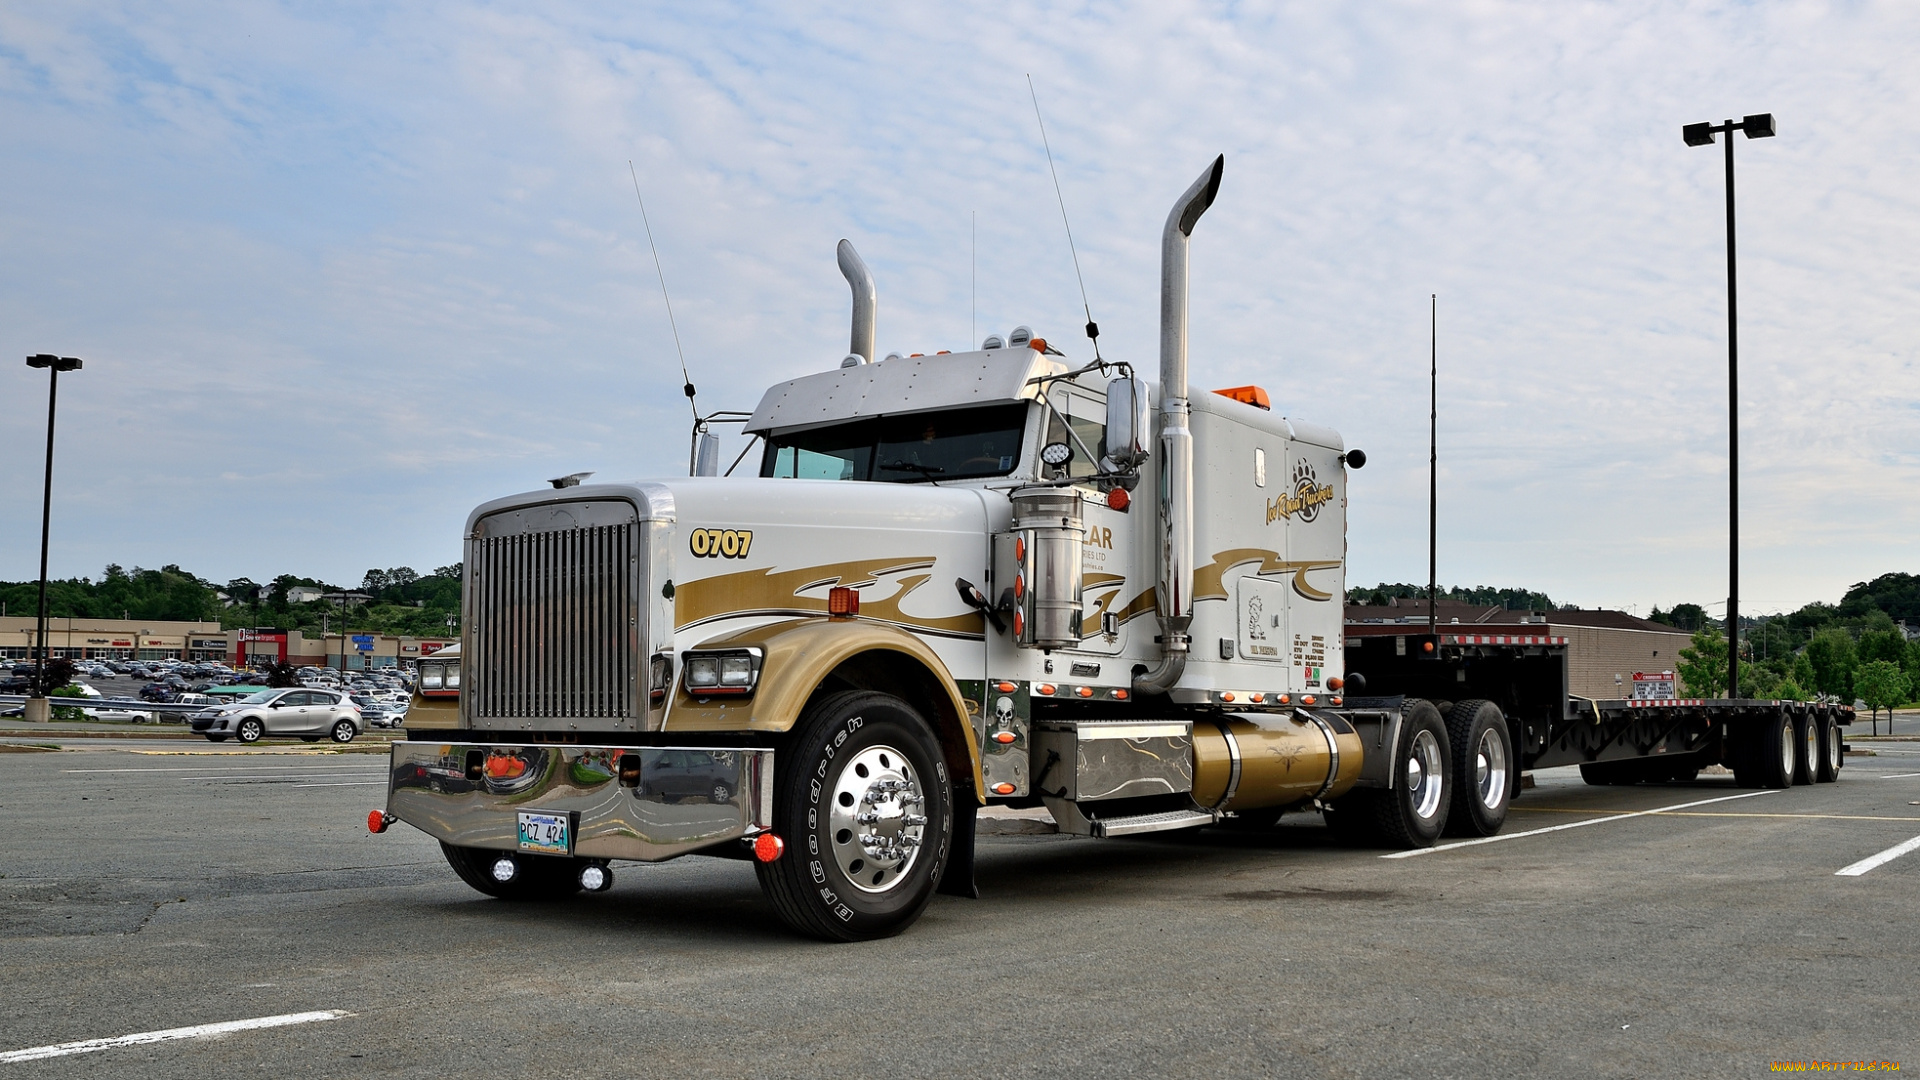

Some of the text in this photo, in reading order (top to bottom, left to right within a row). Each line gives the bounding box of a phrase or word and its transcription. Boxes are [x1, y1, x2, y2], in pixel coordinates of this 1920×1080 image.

[1276, 492, 1301, 520] Road
[1297, 483, 1333, 511] Truckers
[689, 528, 753, 559] 0707
[1096, 552, 1106, 561] LTD
[520, 822, 565, 844] PCZ 424
[808, 716, 864, 922] BFGoodrich
